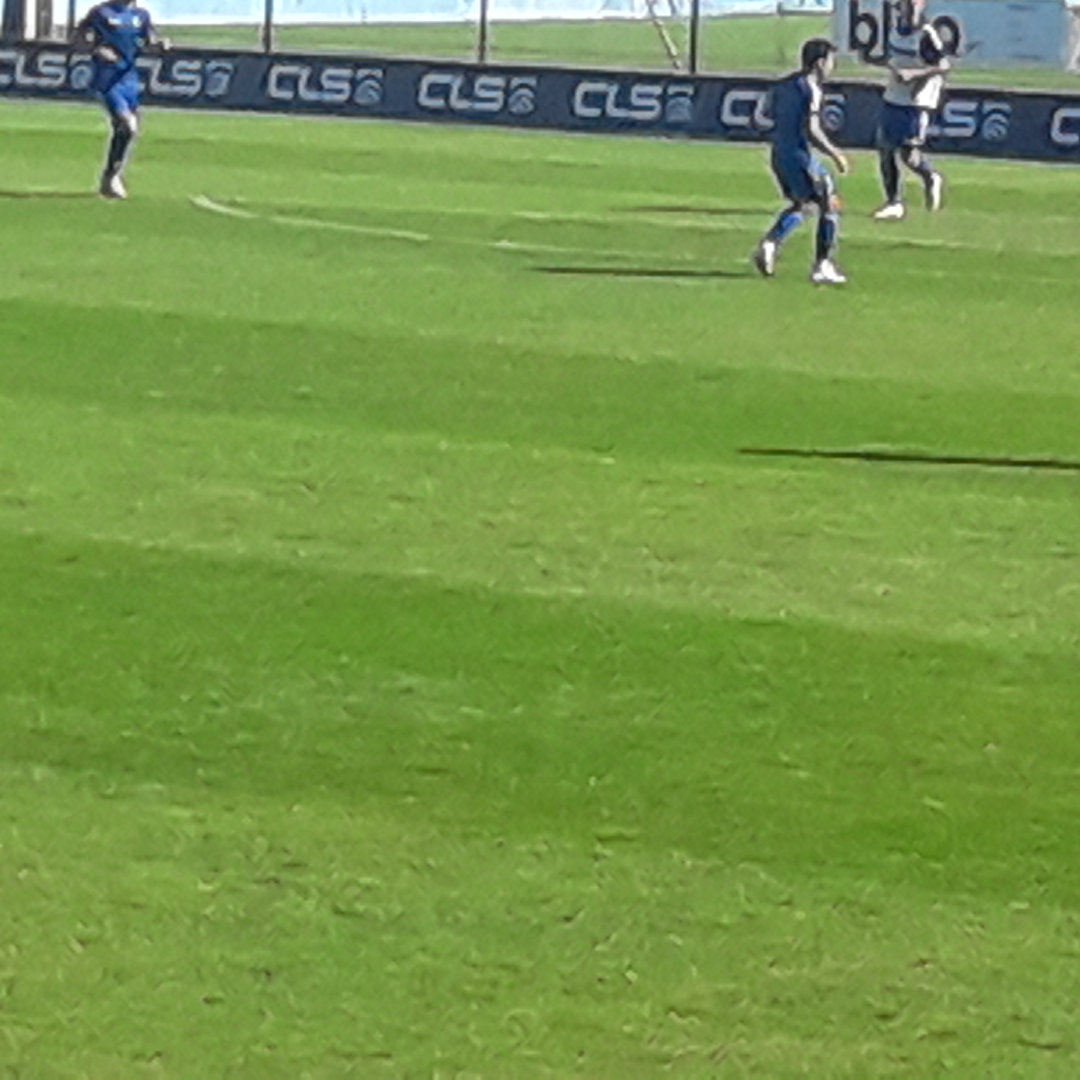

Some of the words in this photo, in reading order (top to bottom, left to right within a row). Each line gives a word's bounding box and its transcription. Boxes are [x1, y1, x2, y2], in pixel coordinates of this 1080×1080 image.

[268, 65, 352, 102] CLS
[418, 73, 505, 111] CLS
[574, 82, 663, 120] CLS
